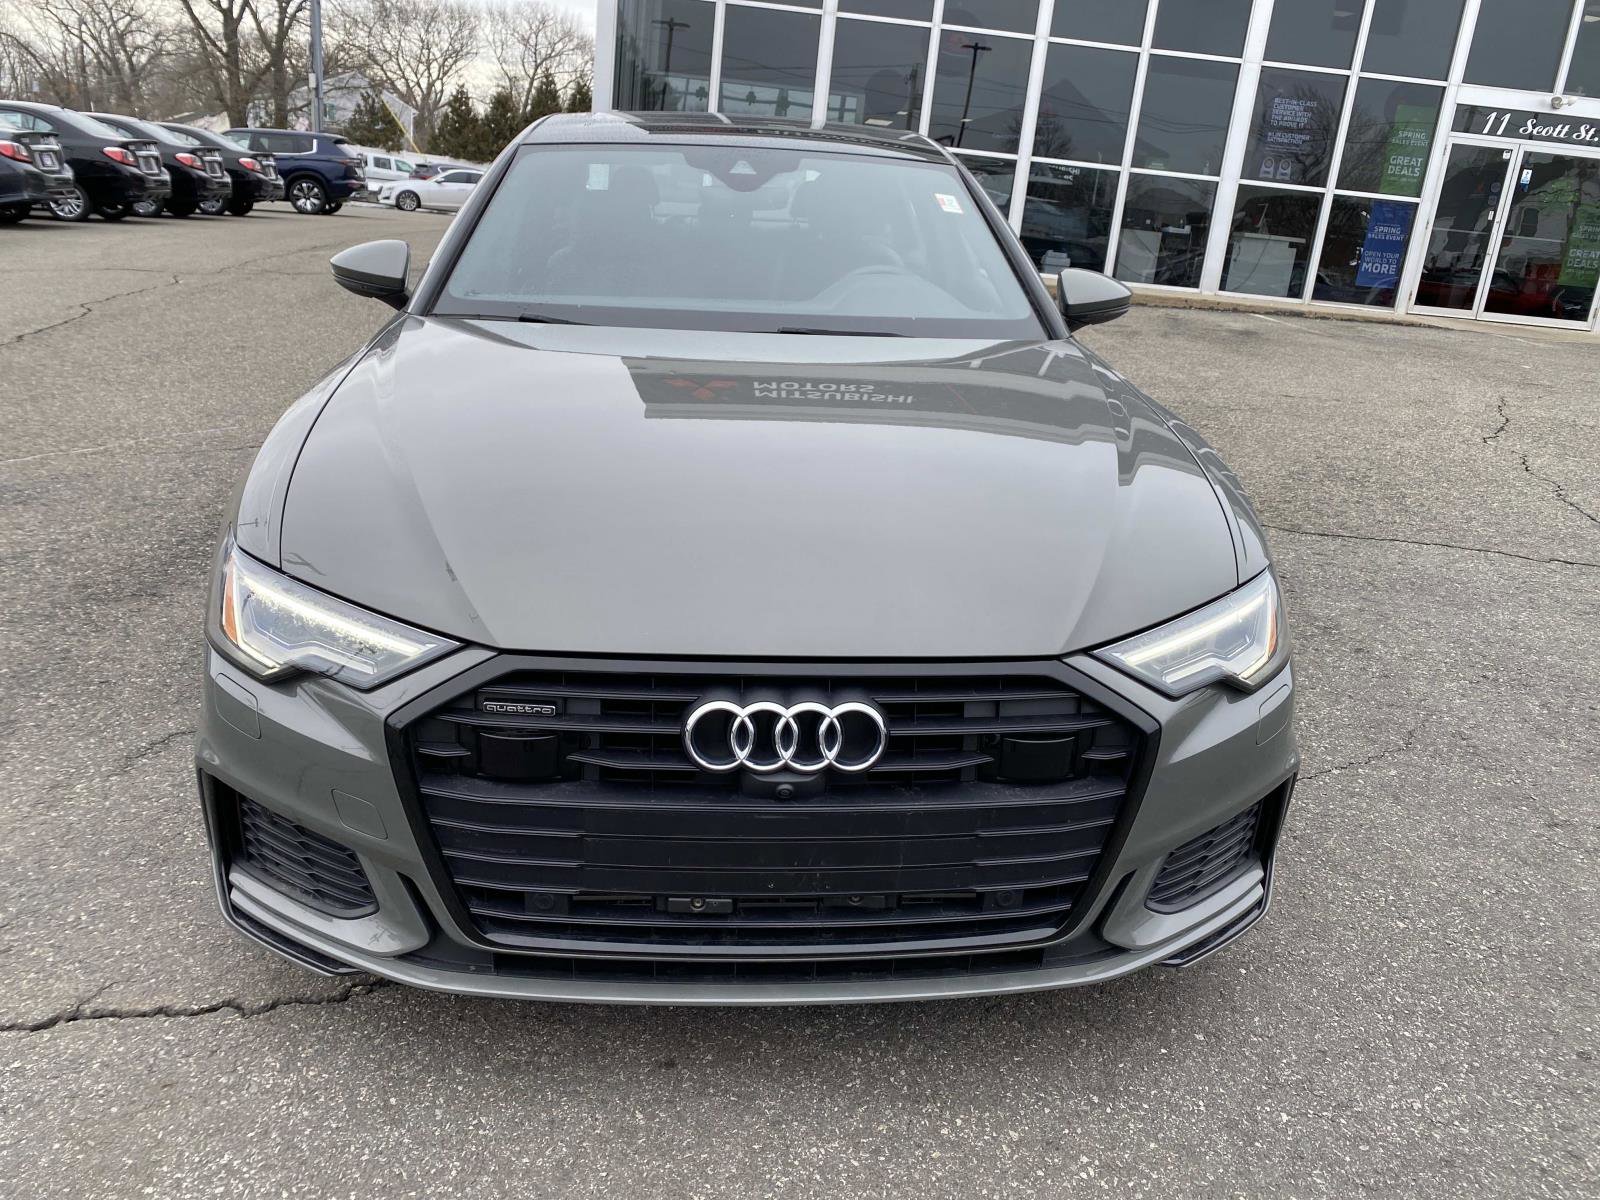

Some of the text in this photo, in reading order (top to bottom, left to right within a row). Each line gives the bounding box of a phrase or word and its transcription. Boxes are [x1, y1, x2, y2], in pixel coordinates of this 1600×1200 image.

[1482, 111, 1599, 142] 11 Scott St.
[1398, 131, 1426, 139] SPRING
[1390, 155, 1423, 167] GREAT
[1387, 165, 1421, 177] DEALS
[1374, 225, 1401, 234] SPRING
[1579, 225, 1600, 233] SPRIN
[1364, 256, 1388, 264] WORLD
[1567, 259, 1598, 269] DEALS
[1361, 262, 1397, 275] MORE
[486, 704, 552, 714] quattro
